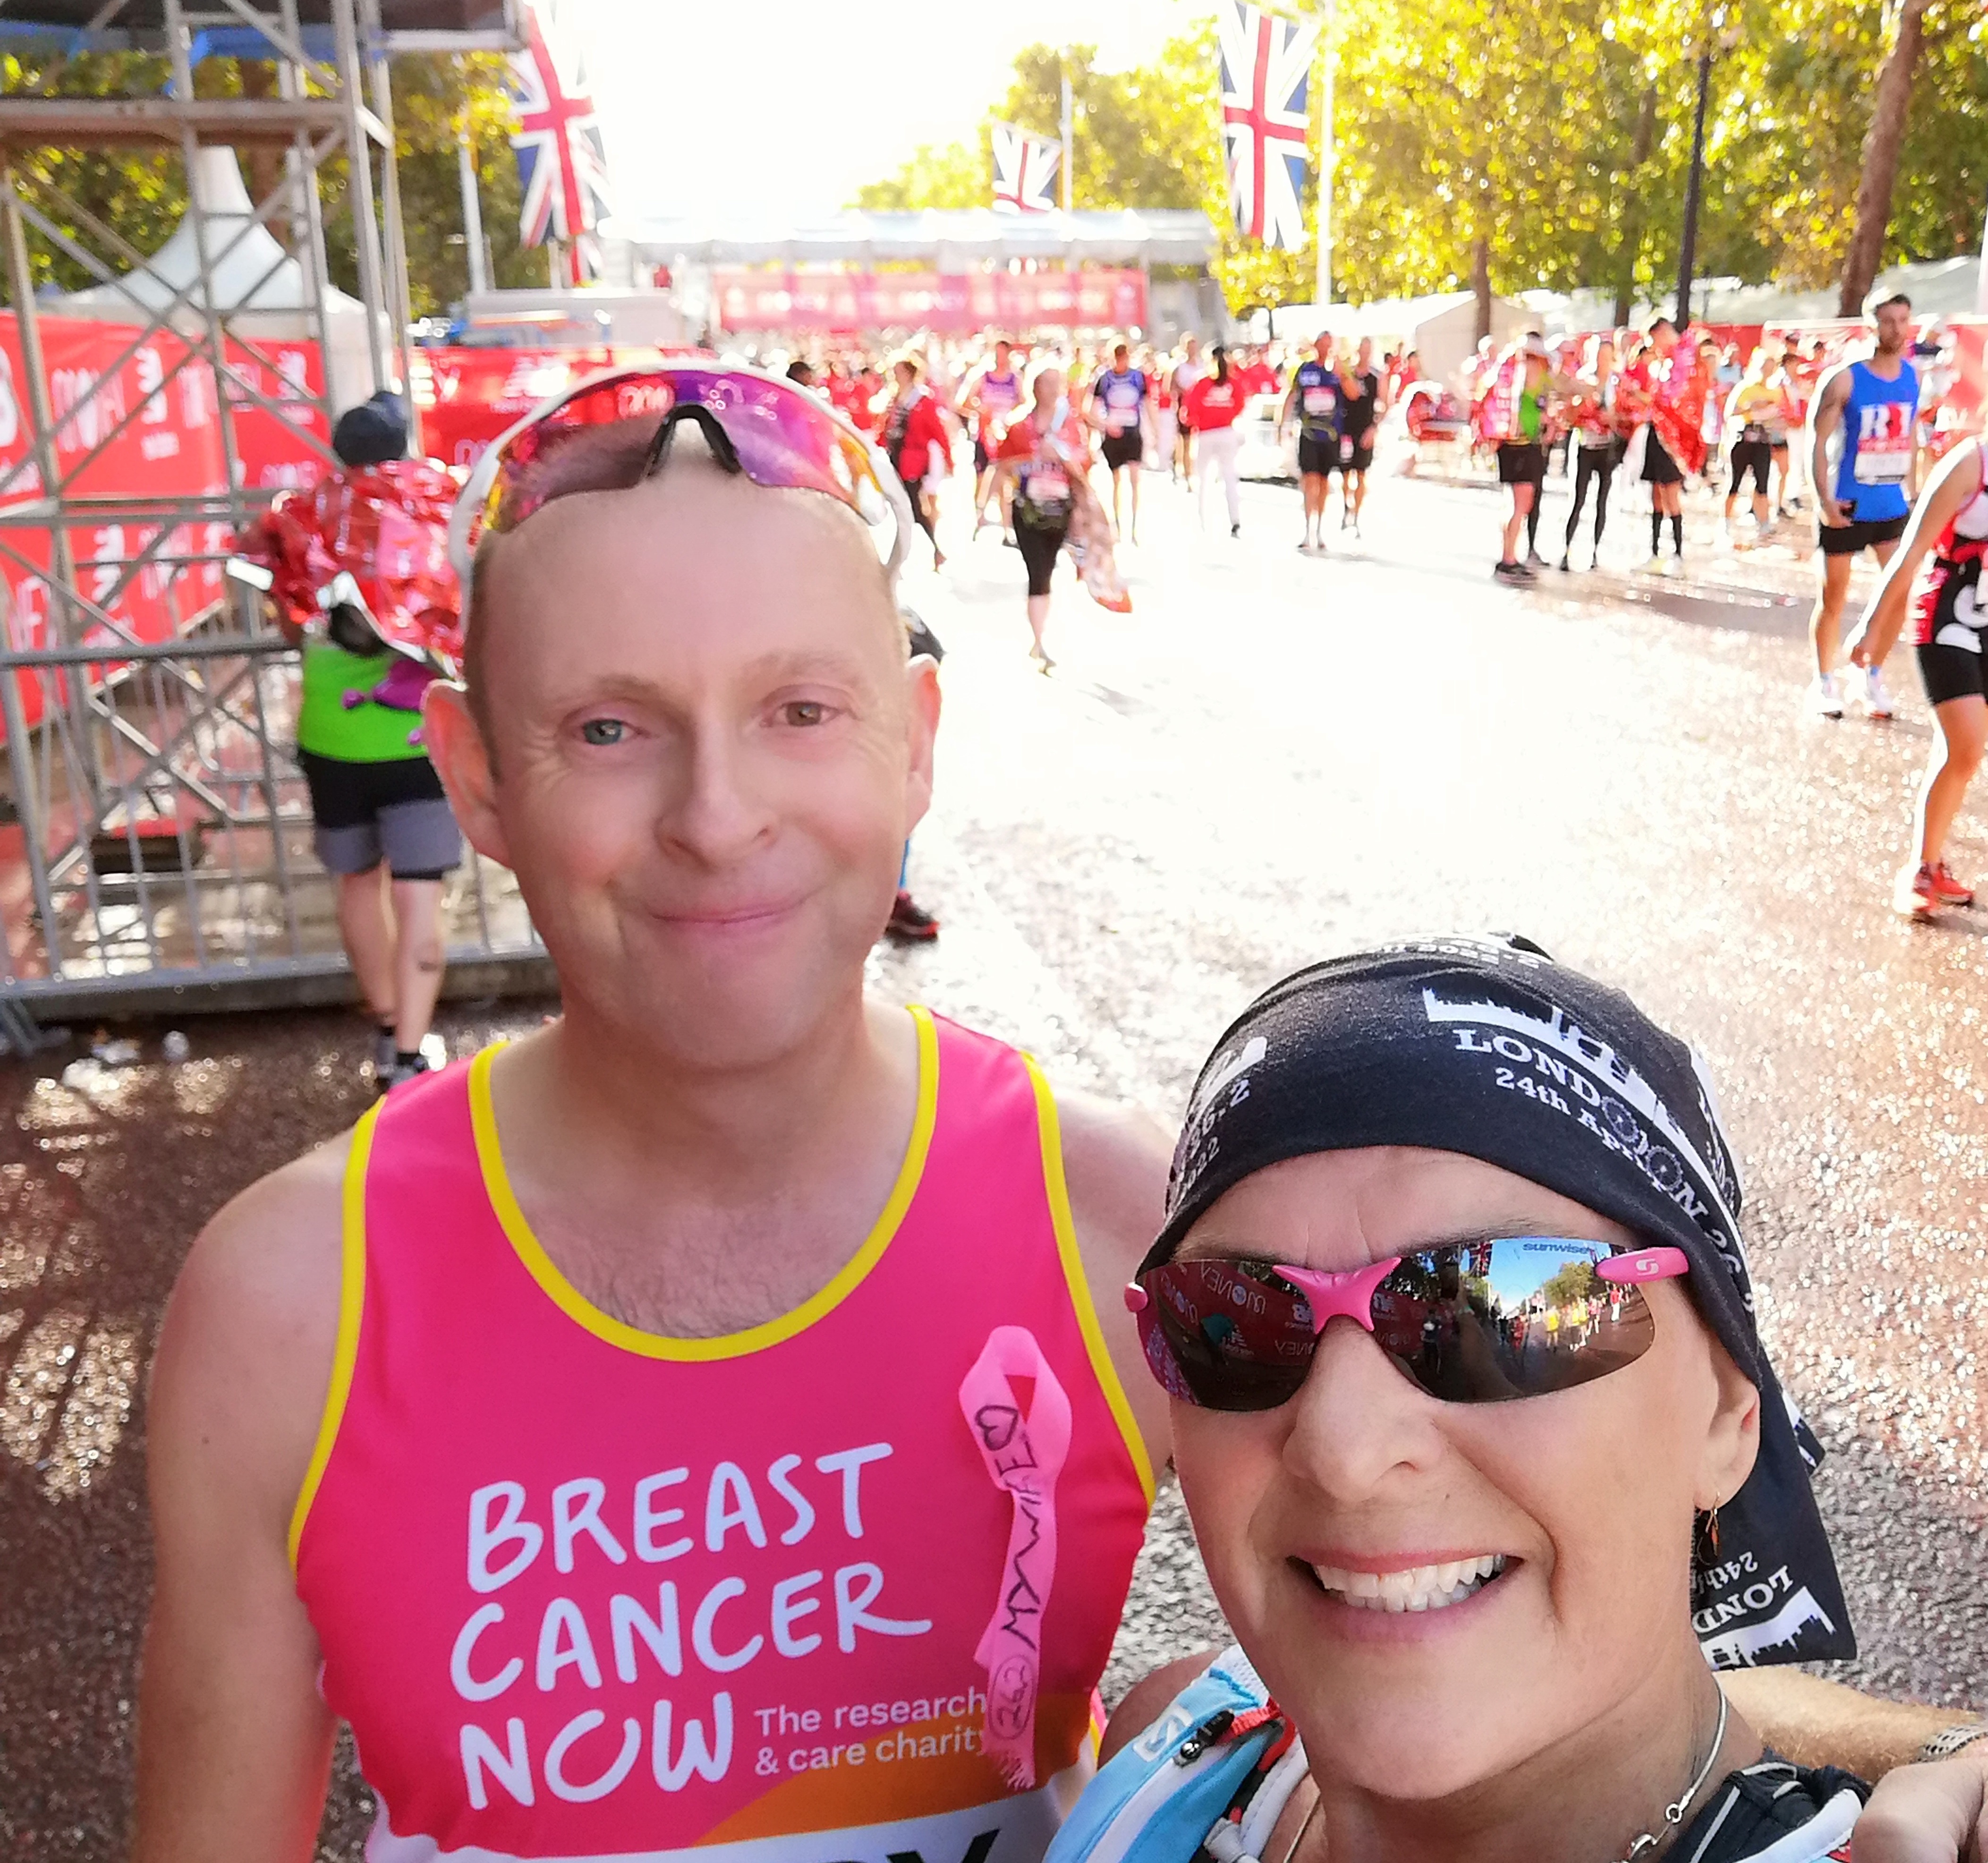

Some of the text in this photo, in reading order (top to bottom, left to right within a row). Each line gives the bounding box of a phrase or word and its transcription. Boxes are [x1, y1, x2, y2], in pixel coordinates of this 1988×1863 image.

[1495, 1068, 1572, 1116] 24th
[1522, 1243, 1589, 1254] sunwise
[467, 1442, 893, 1594] BREAST
[450, 1562, 933, 1702] CANCER
[754, 1685, 986, 1736] The research
[459, 1691, 734, 1810] NOW
[755, 1746, 780, 1776] &
[787, 1741, 867, 1772] care
